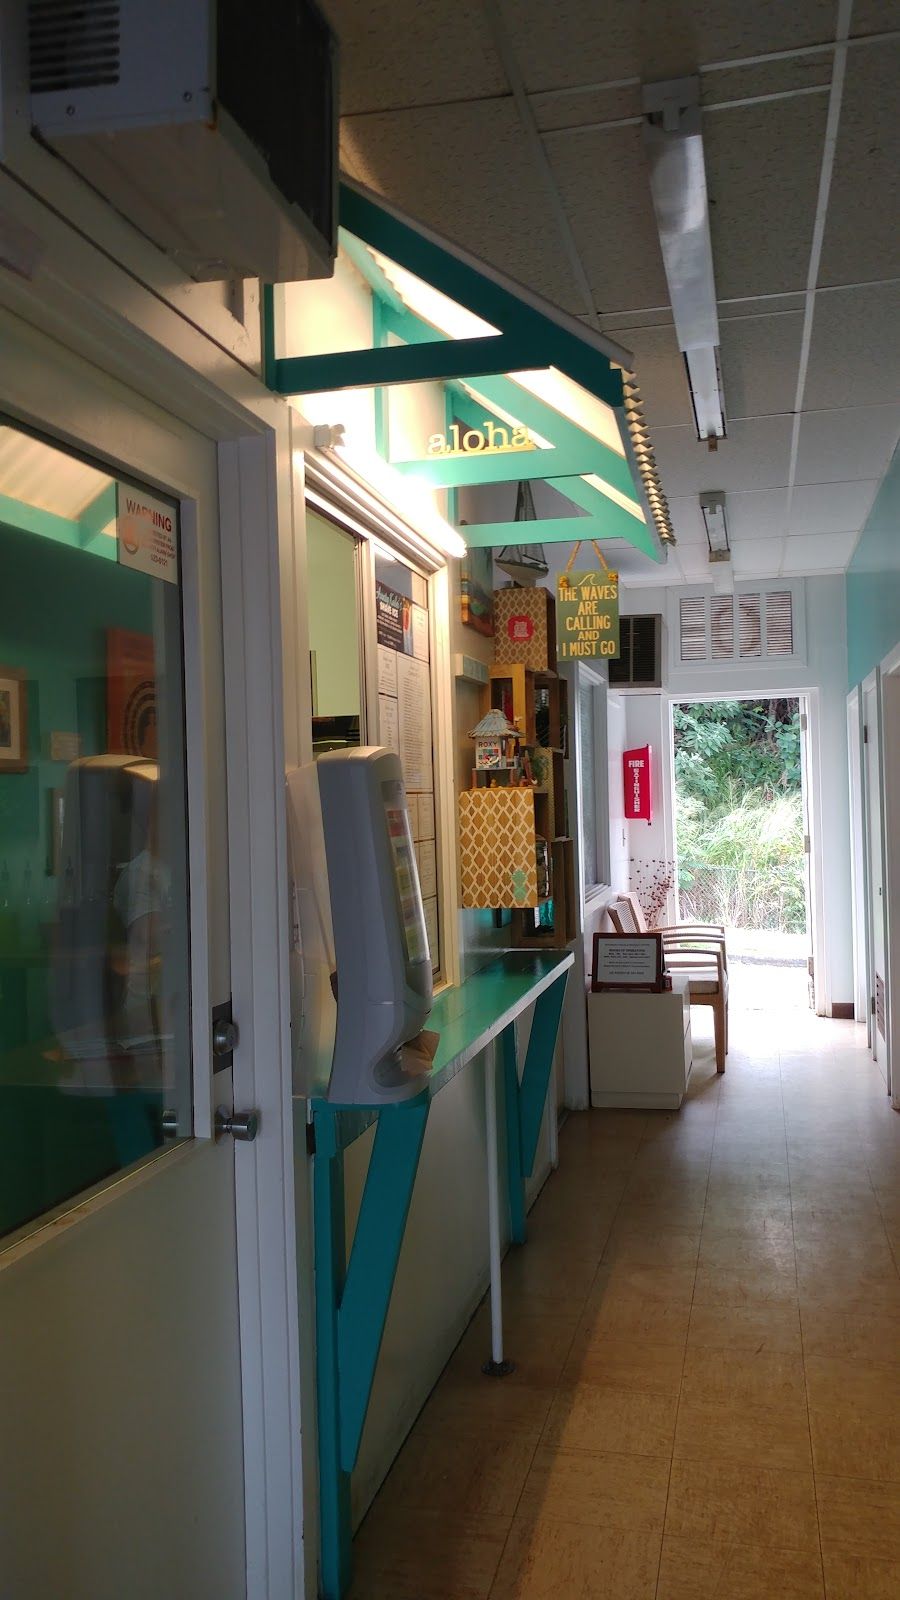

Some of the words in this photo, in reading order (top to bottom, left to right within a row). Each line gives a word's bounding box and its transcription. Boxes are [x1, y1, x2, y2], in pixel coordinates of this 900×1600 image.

[427, 421, 533, 454] aloha
[126, 498, 172, 532] WARNING
[558, 586, 578, 601] THE
[580, 585, 617, 600] WAVES
[578, 601, 598, 615] ARE
[566, 615, 611, 630] CALLING
[577, 631, 600, 640] AND
[562, 642, 567, 657] I
[569, 641, 597, 656] MUST
[600, 640, 616, 655] GO
[628, 760, 645, 768] FIRE
